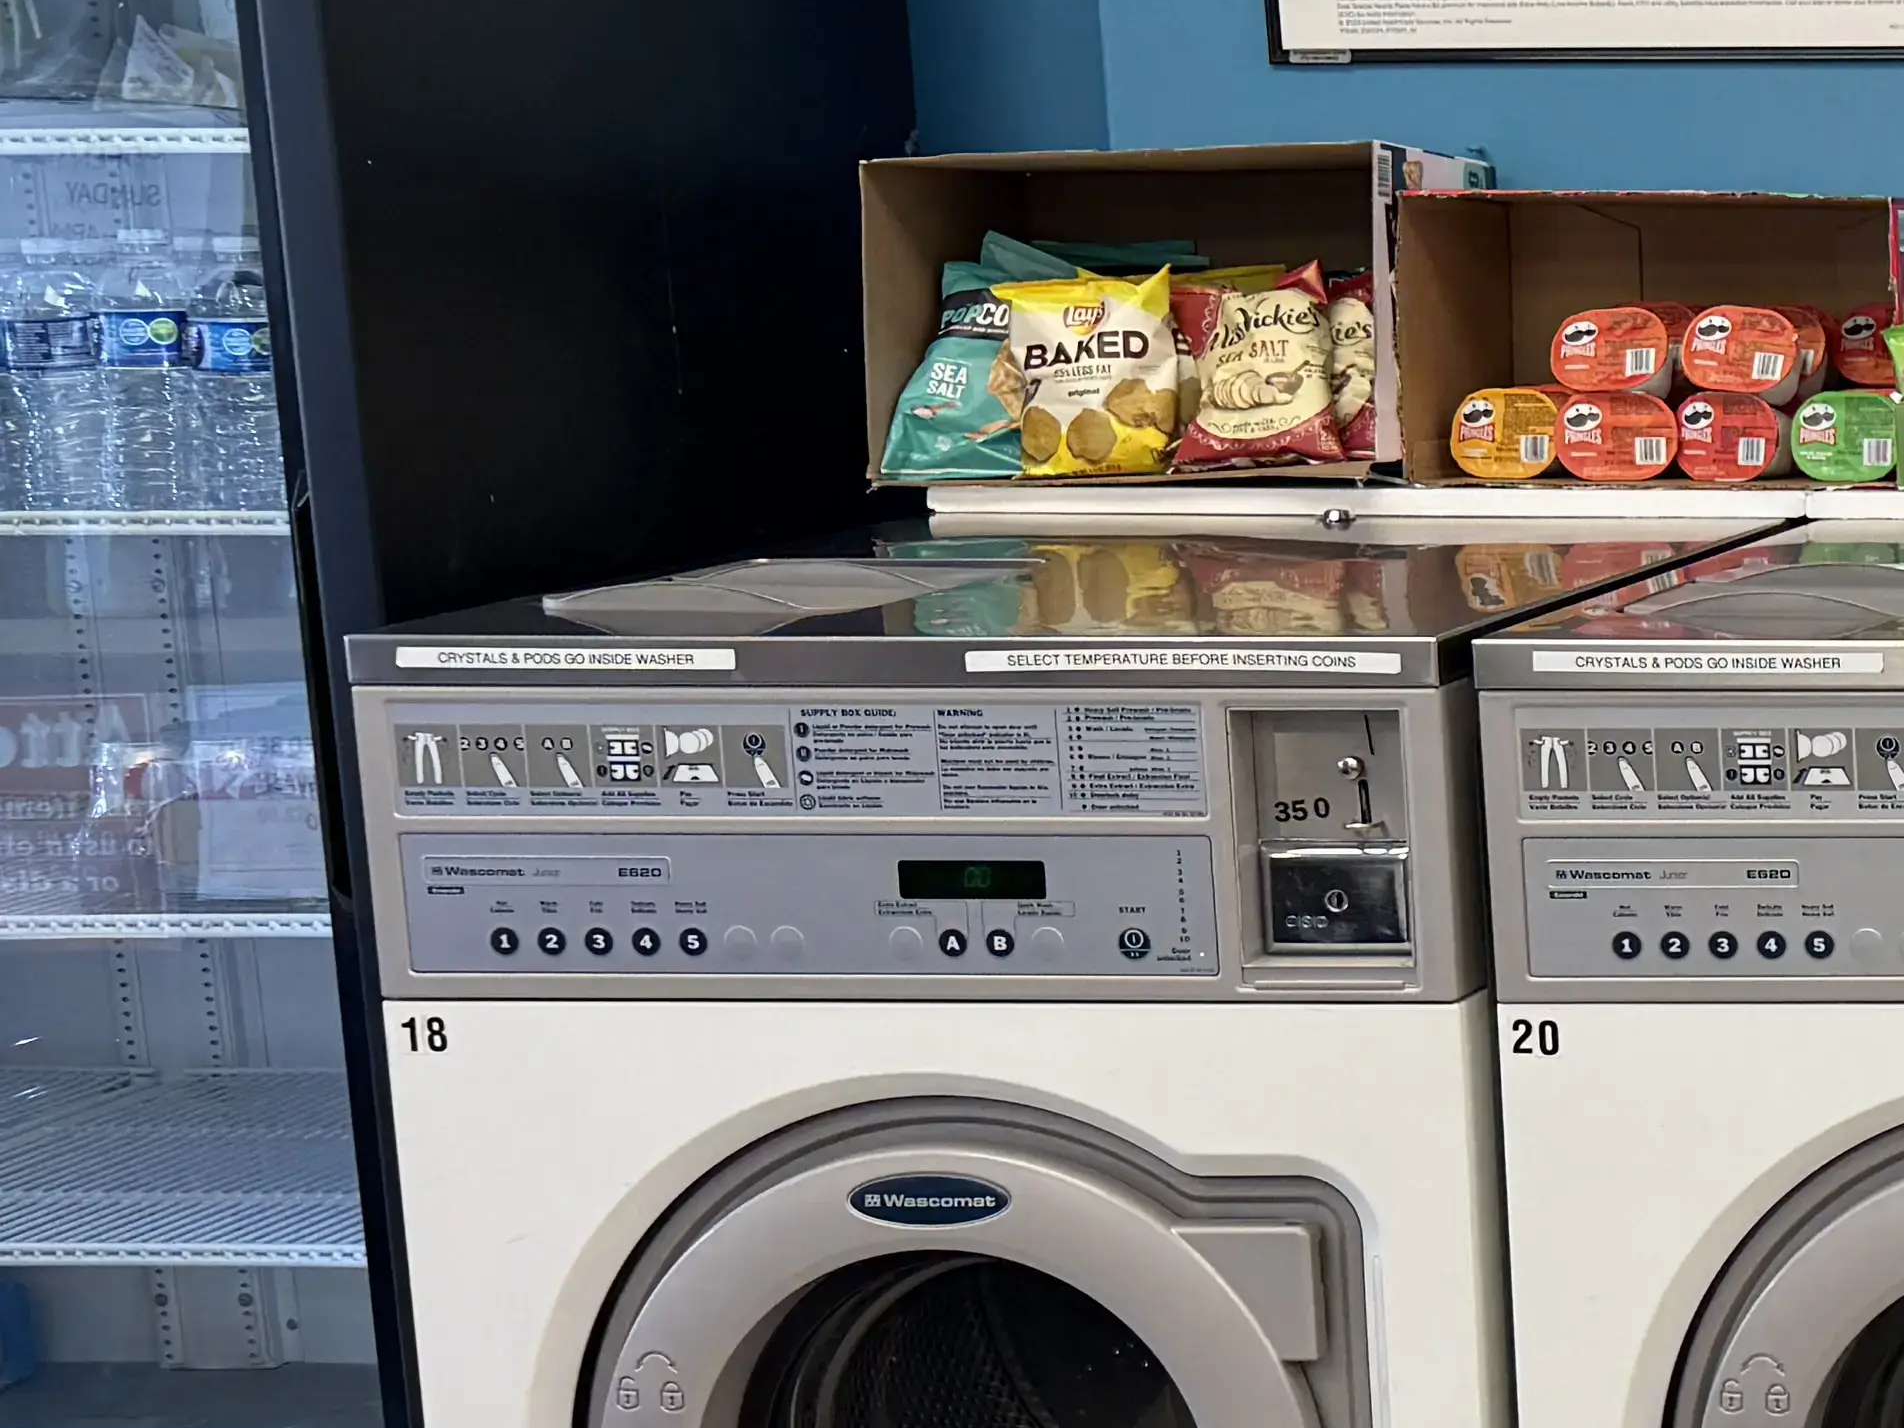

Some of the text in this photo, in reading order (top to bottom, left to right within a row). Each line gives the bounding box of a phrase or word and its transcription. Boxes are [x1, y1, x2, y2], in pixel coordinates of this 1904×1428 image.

[1024, 331, 1149, 370] BAKED
[931, 362, 967, 384] SEA
[927, 381, 966, 399] SALT
[437, 651, 695, 666] CRYSTALS & PODS GO INSIDE WASHER
[401, 1017, 447, 1052] 18
[1512, 1019, 1559, 1055] 20
[883, 1193, 996, 1208] Wascomat
